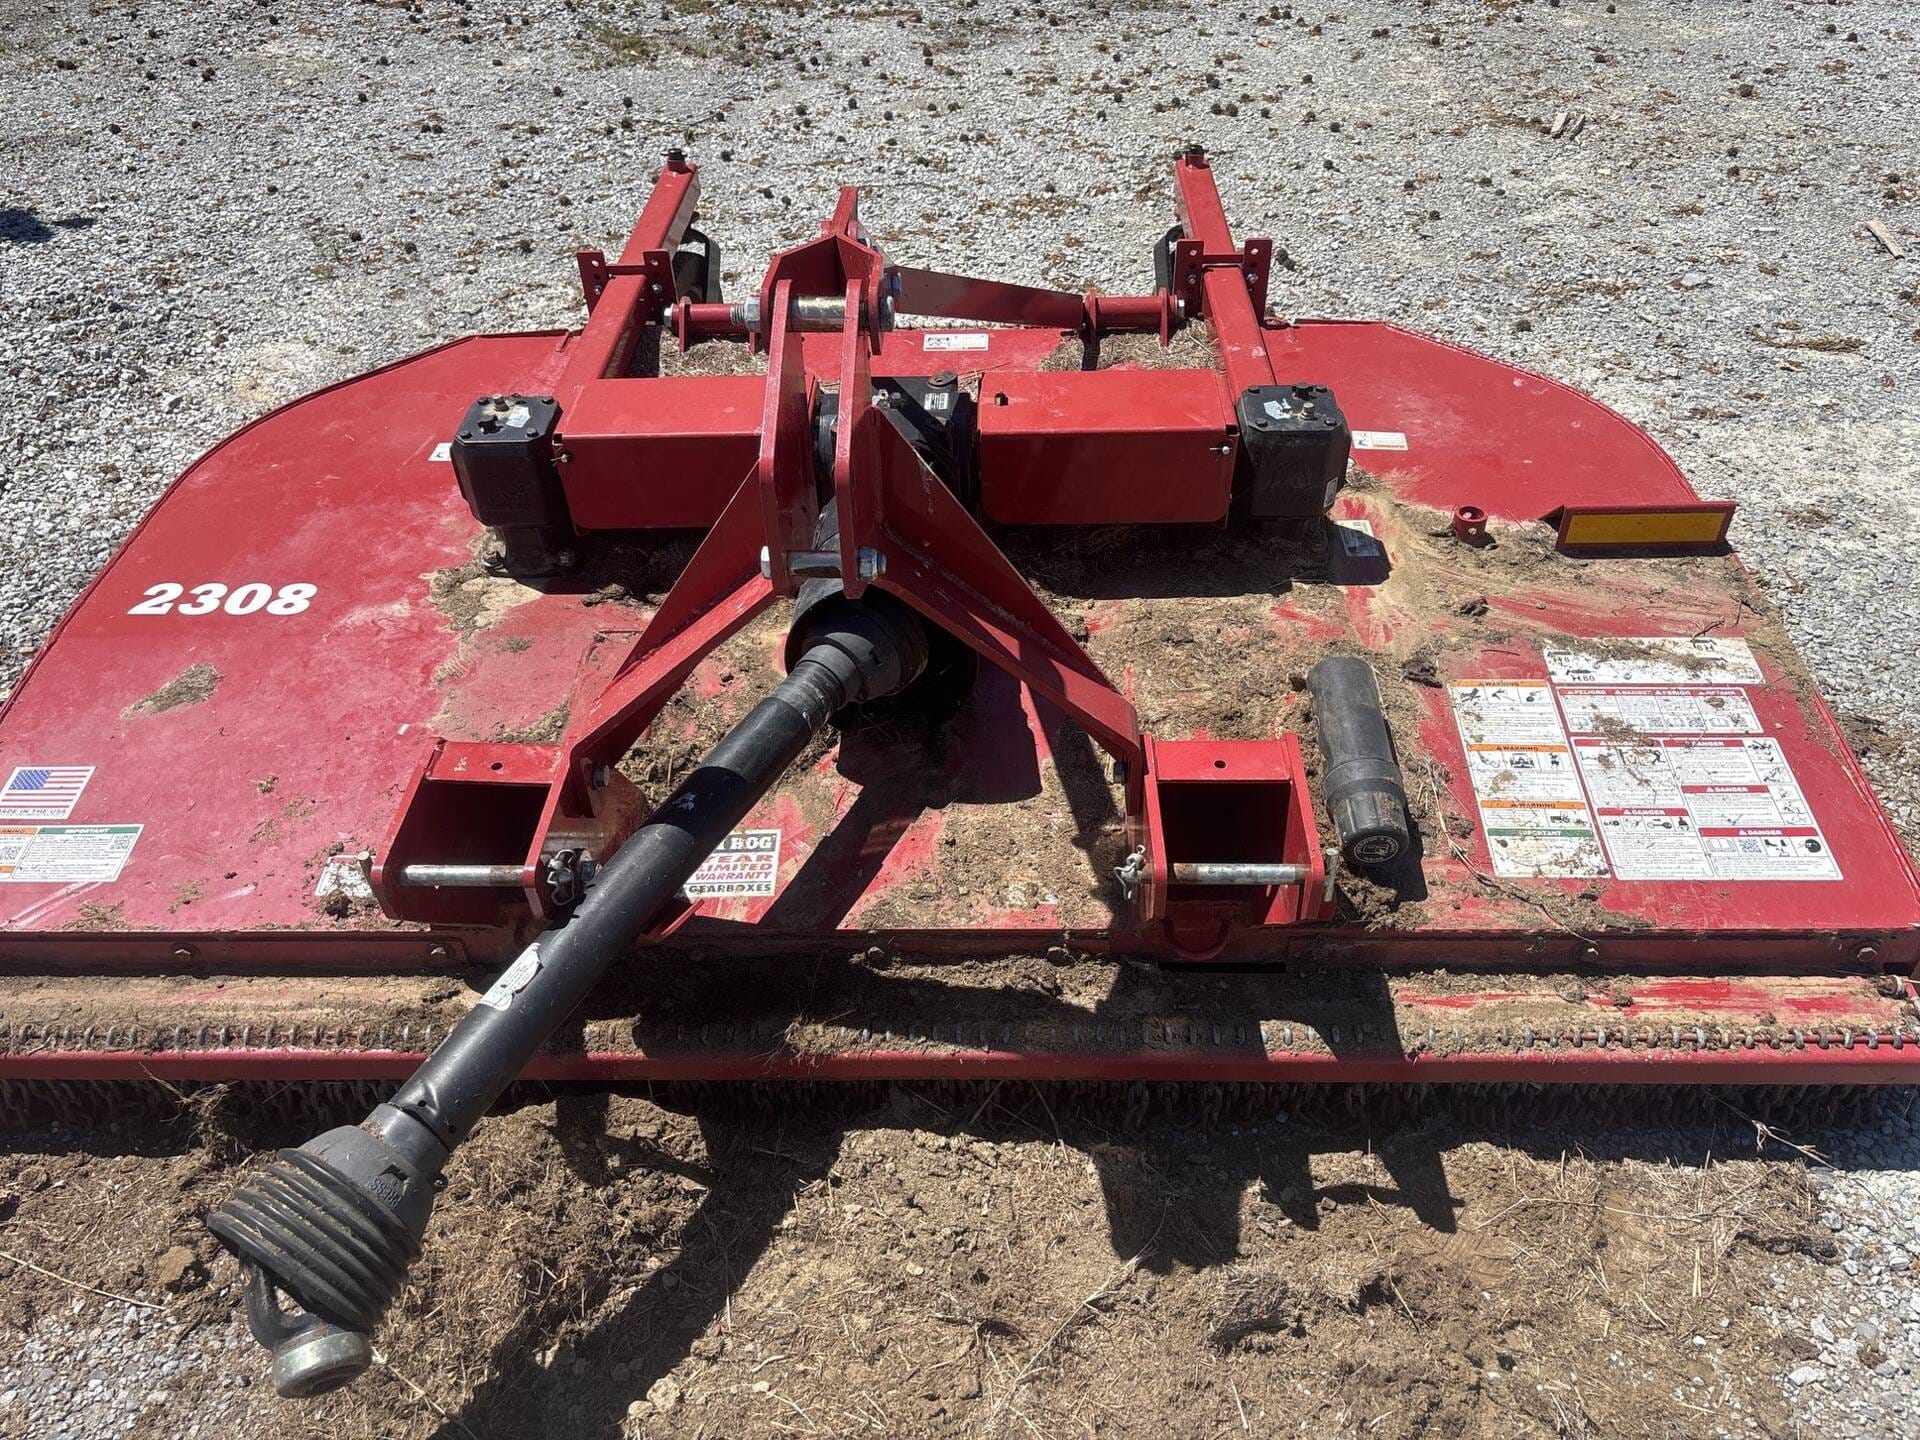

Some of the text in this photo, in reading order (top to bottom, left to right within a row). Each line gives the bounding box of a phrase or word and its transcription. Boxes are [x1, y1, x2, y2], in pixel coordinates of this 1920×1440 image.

[127, 582, 318, 615] 2308
[695, 871, 772, 881] WARRANTY
[688, 884, 772, 893] GEARBOXES
